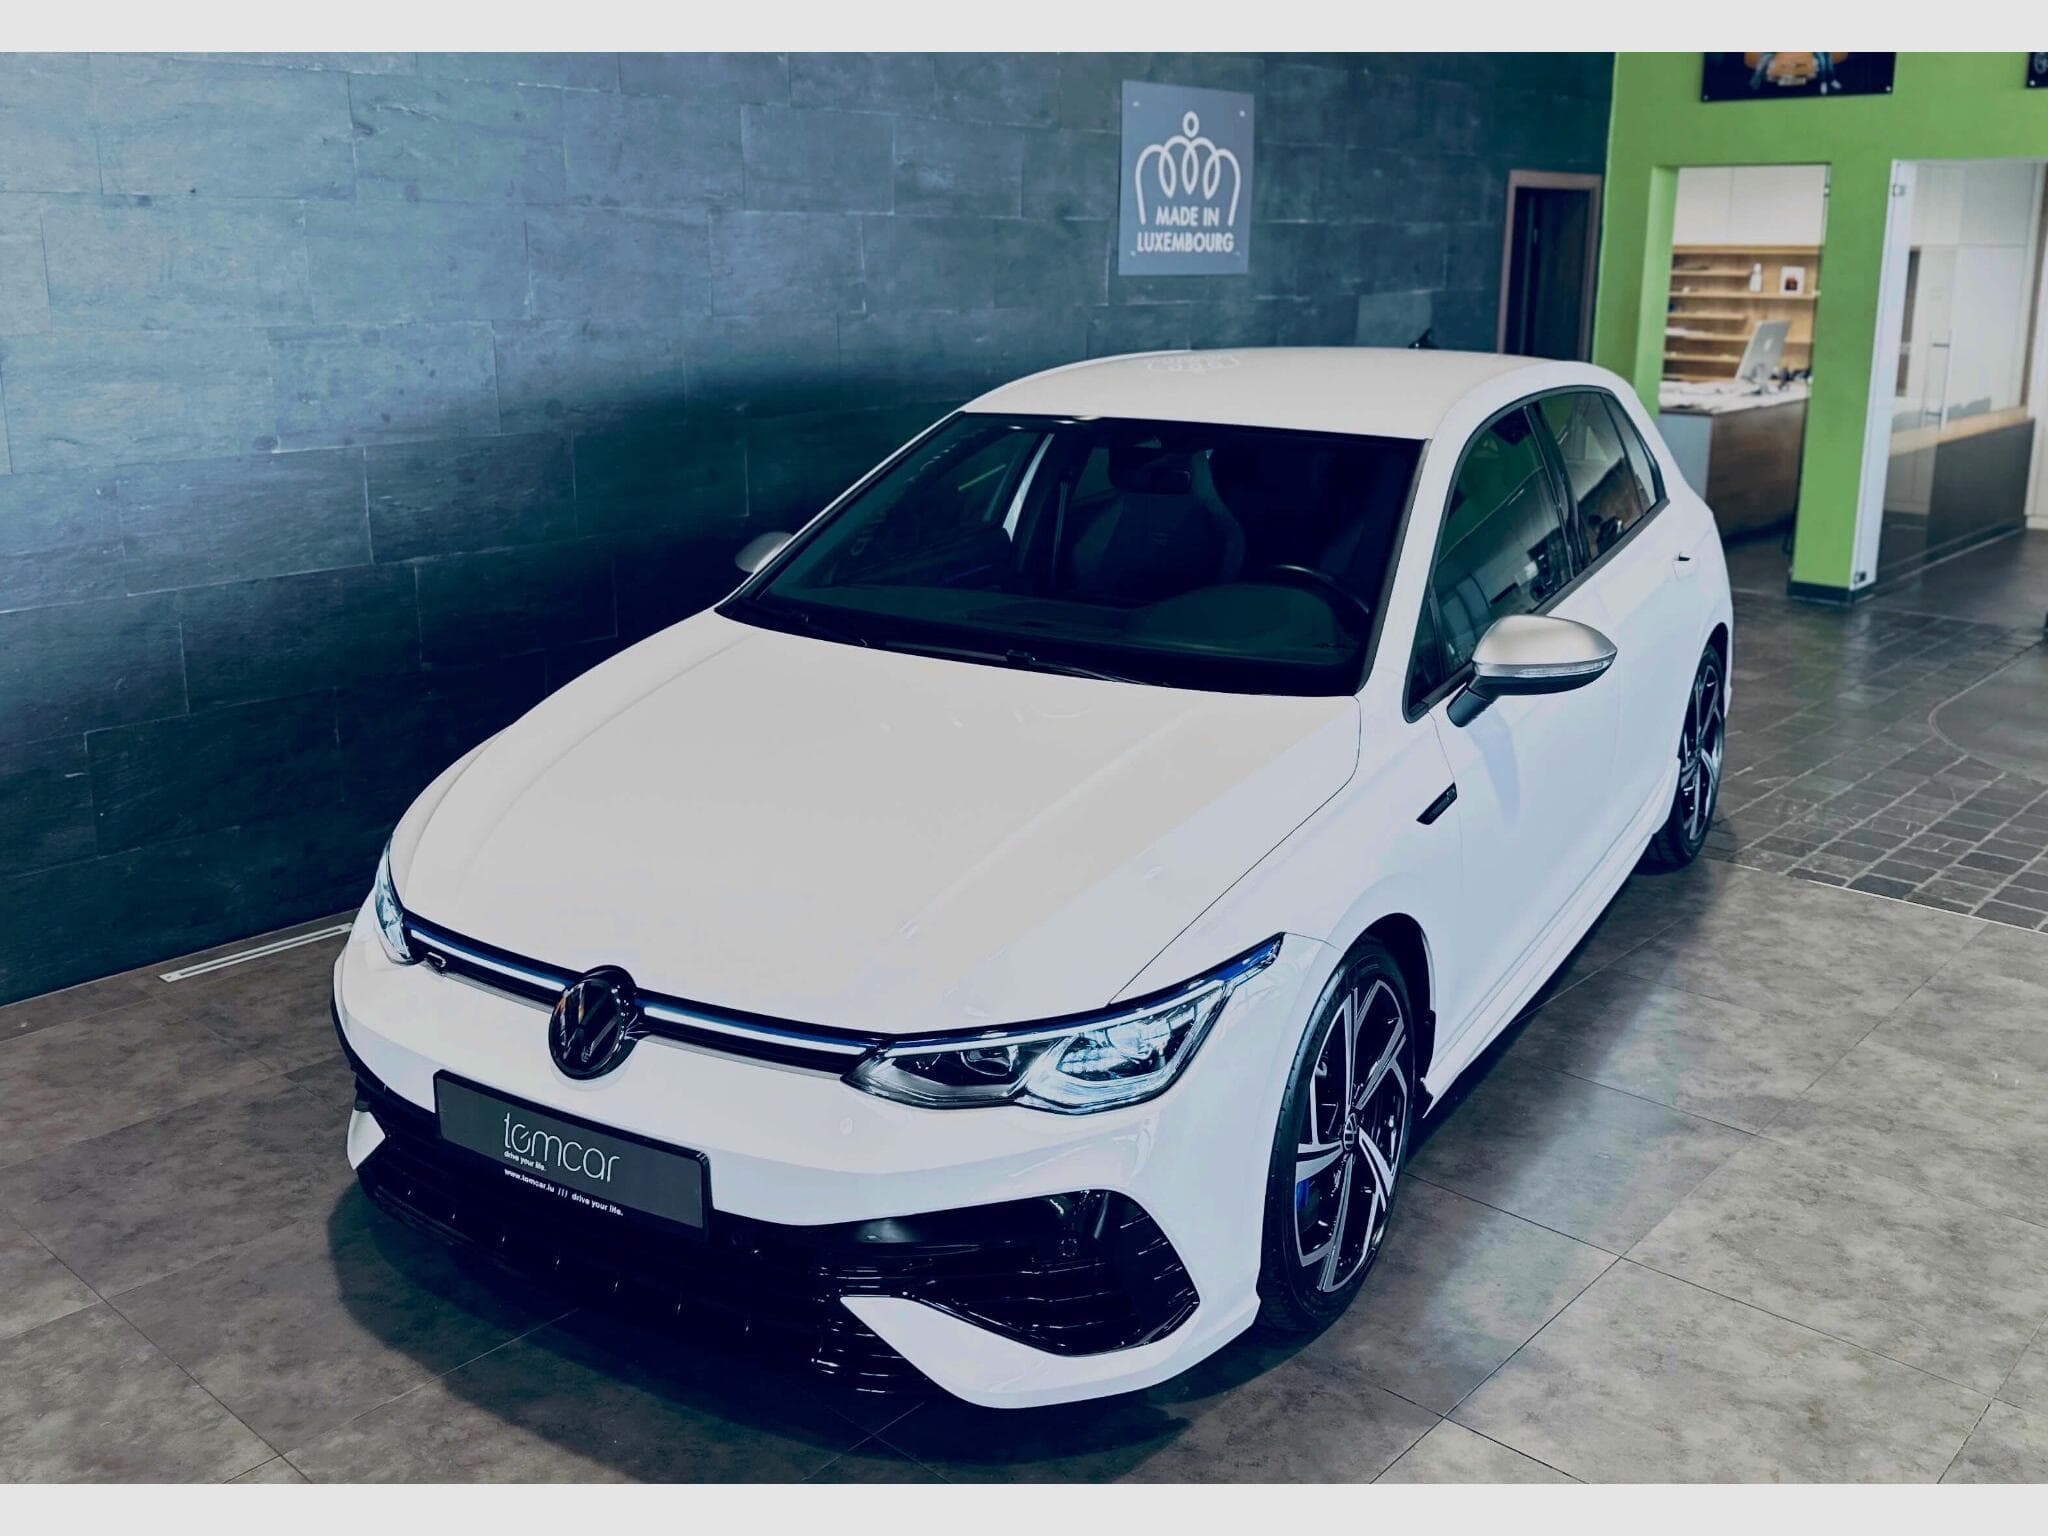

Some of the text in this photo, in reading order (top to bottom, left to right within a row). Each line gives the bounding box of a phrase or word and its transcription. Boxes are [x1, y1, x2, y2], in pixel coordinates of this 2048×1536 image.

[1156, 206, 1219, 227] MADE IN
[1137, 232, 1234, 252] LUXEMBOURG
[504, 1151, 519, 1161] drive
[520, 1157, 534, 1167] your
[571, 1194, 590, 1205] drive
[591, 1200, 608, 1212] your
